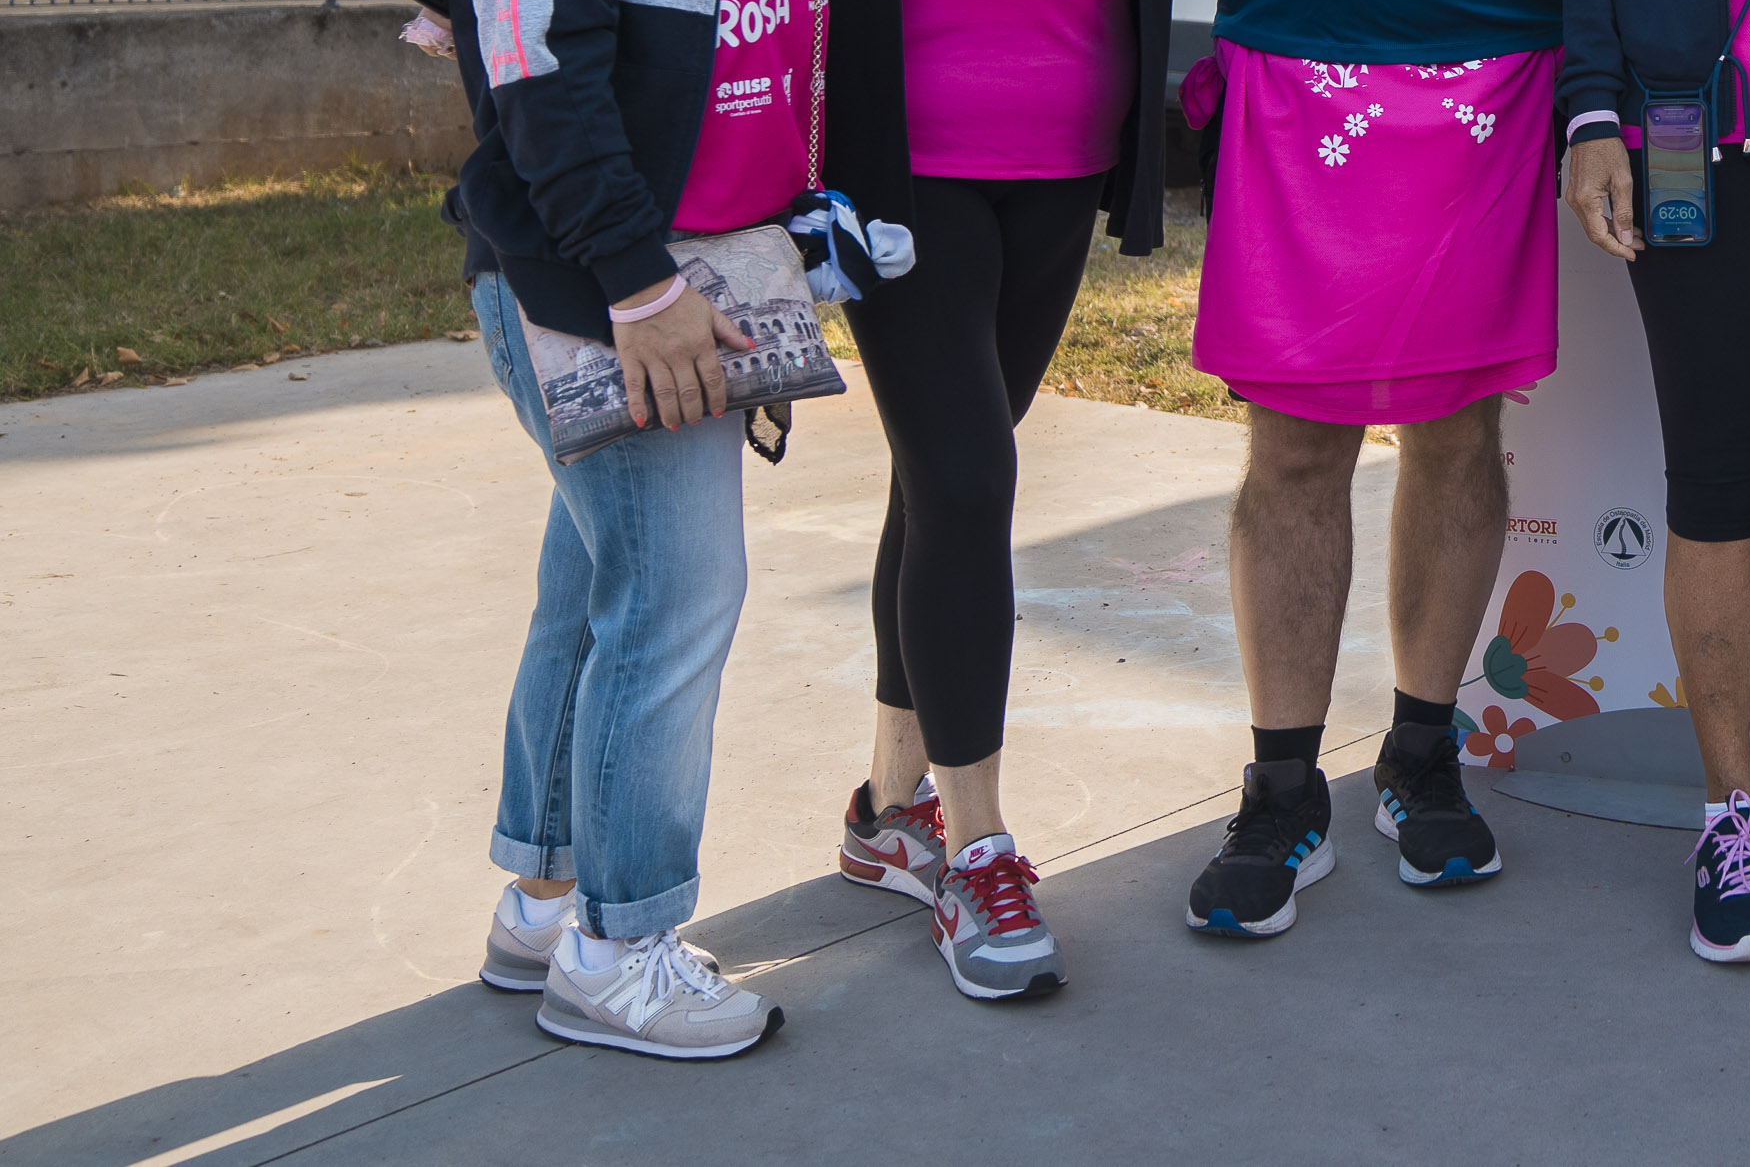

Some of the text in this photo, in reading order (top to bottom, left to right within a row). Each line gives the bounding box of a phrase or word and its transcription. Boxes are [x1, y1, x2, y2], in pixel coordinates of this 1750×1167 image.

[731, 76, 772, 96] UISP
[715, 93, 773, 114] sportpertutti
[1658, 206, 1698, 220] 09:29
[1528, 536, 1557, 545] terra
[970, 845, 985, 858] NIKE
